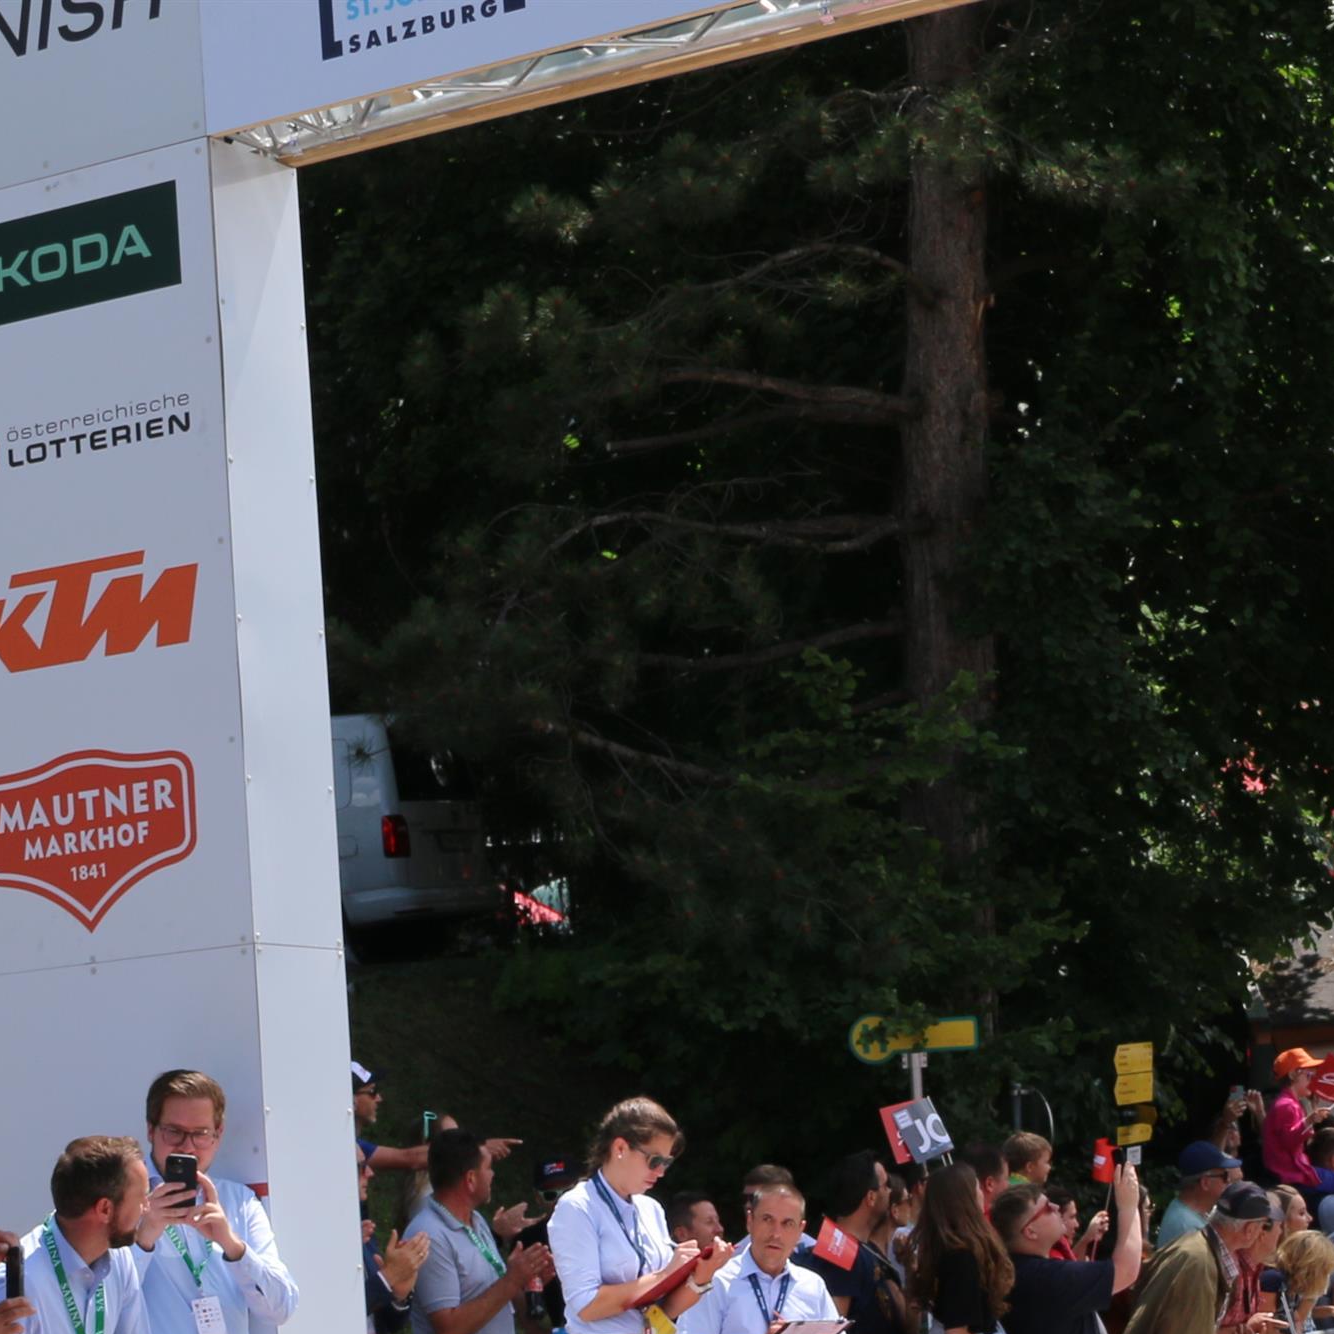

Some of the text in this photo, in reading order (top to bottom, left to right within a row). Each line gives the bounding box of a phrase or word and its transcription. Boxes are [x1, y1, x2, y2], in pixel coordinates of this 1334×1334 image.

[349, 0, 498, 53] SALZBURG
[6, 392, 190, 443] österreichische
[7, 412, 191, 468] LOTTERIEN
[23, 821, 150, 861] MARKHOF
[69, 862, 107, 882] 1841
[60, 1282, 83, 1329] SAMINA
